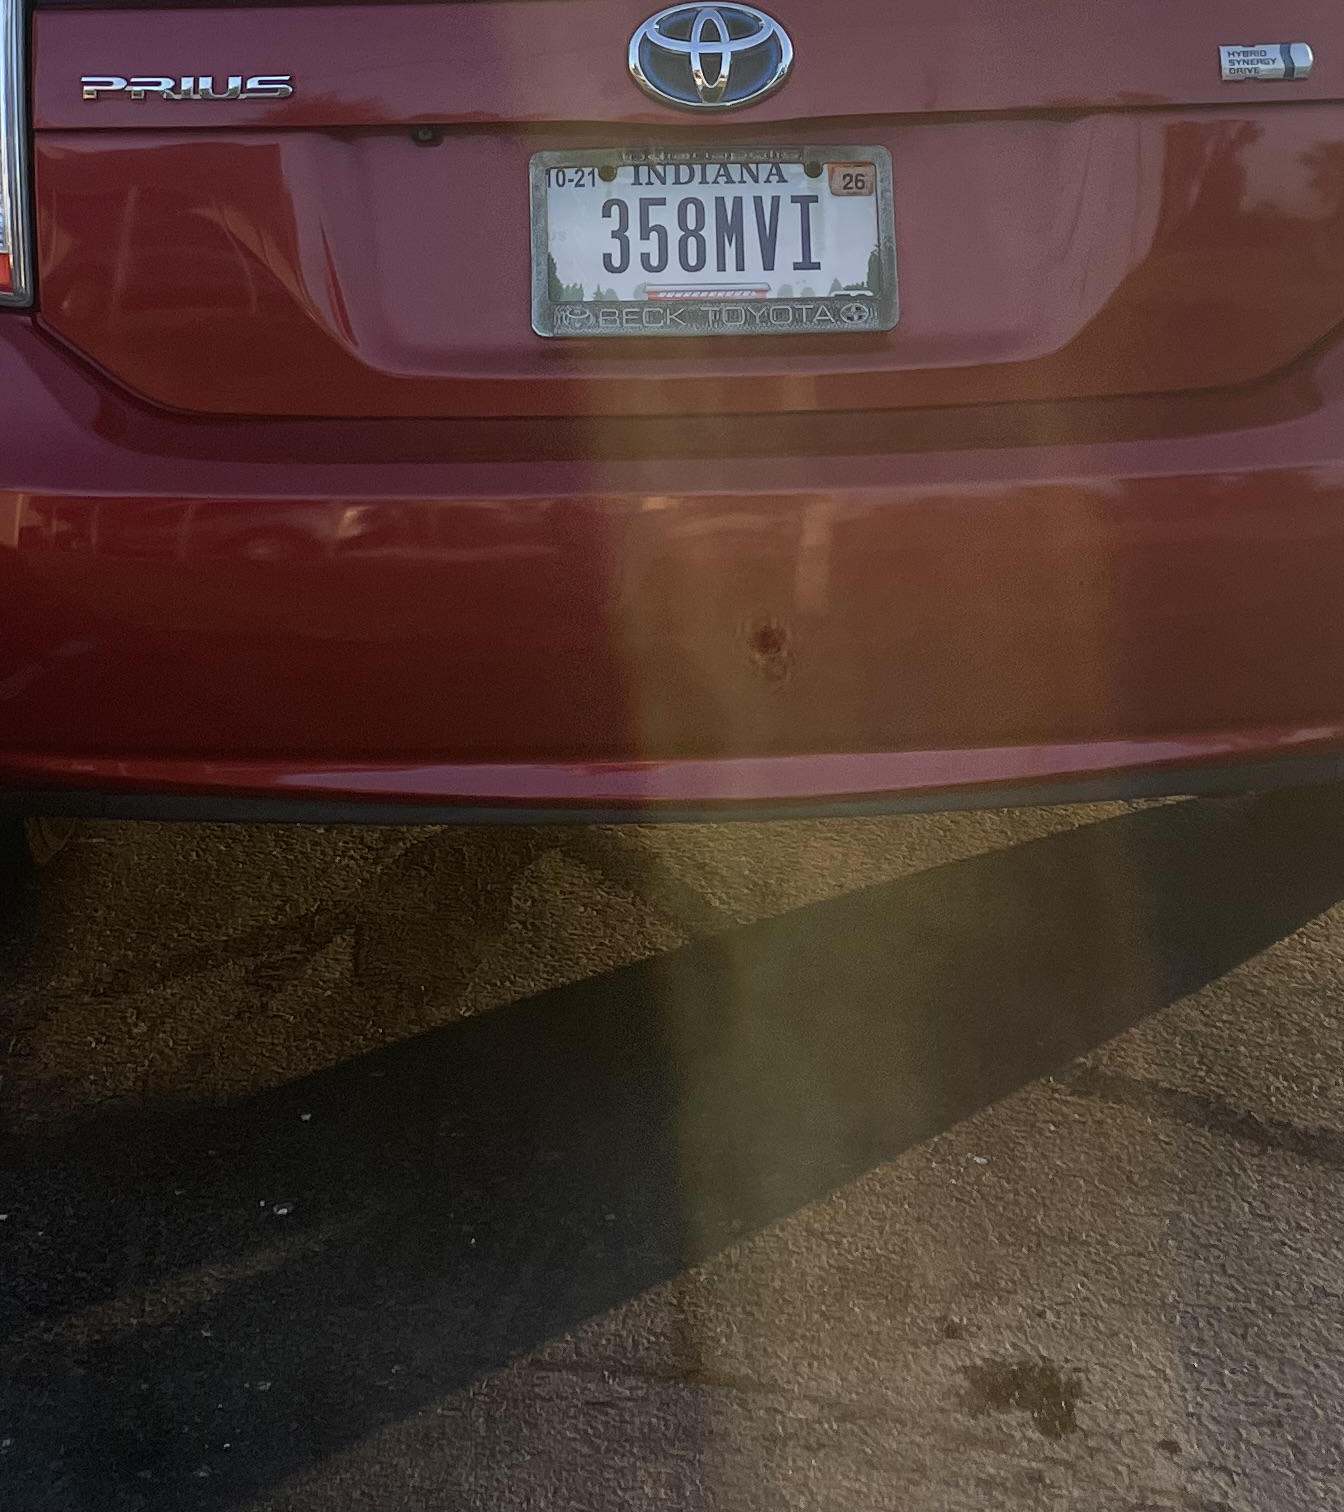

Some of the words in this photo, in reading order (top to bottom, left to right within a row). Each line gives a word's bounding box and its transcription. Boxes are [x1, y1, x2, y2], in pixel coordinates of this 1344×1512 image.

[1227, 50, 1267, 58] HYBRID
[1228, 57, 1277, 66] SYNERGY
[1228, 67, 1261, 75] DRIVE
[80, 75, 293, 100] PRIUS
[545, 167, 597, 189] 10-21
[630, 162, 789, 186] INDIANA
[842, 173, 866, 191] 26
[601, 194, 822, 274] 358MVI
[599, 307, 687, 328] BECK
[700, 304, 836, 327] TOYOTA
